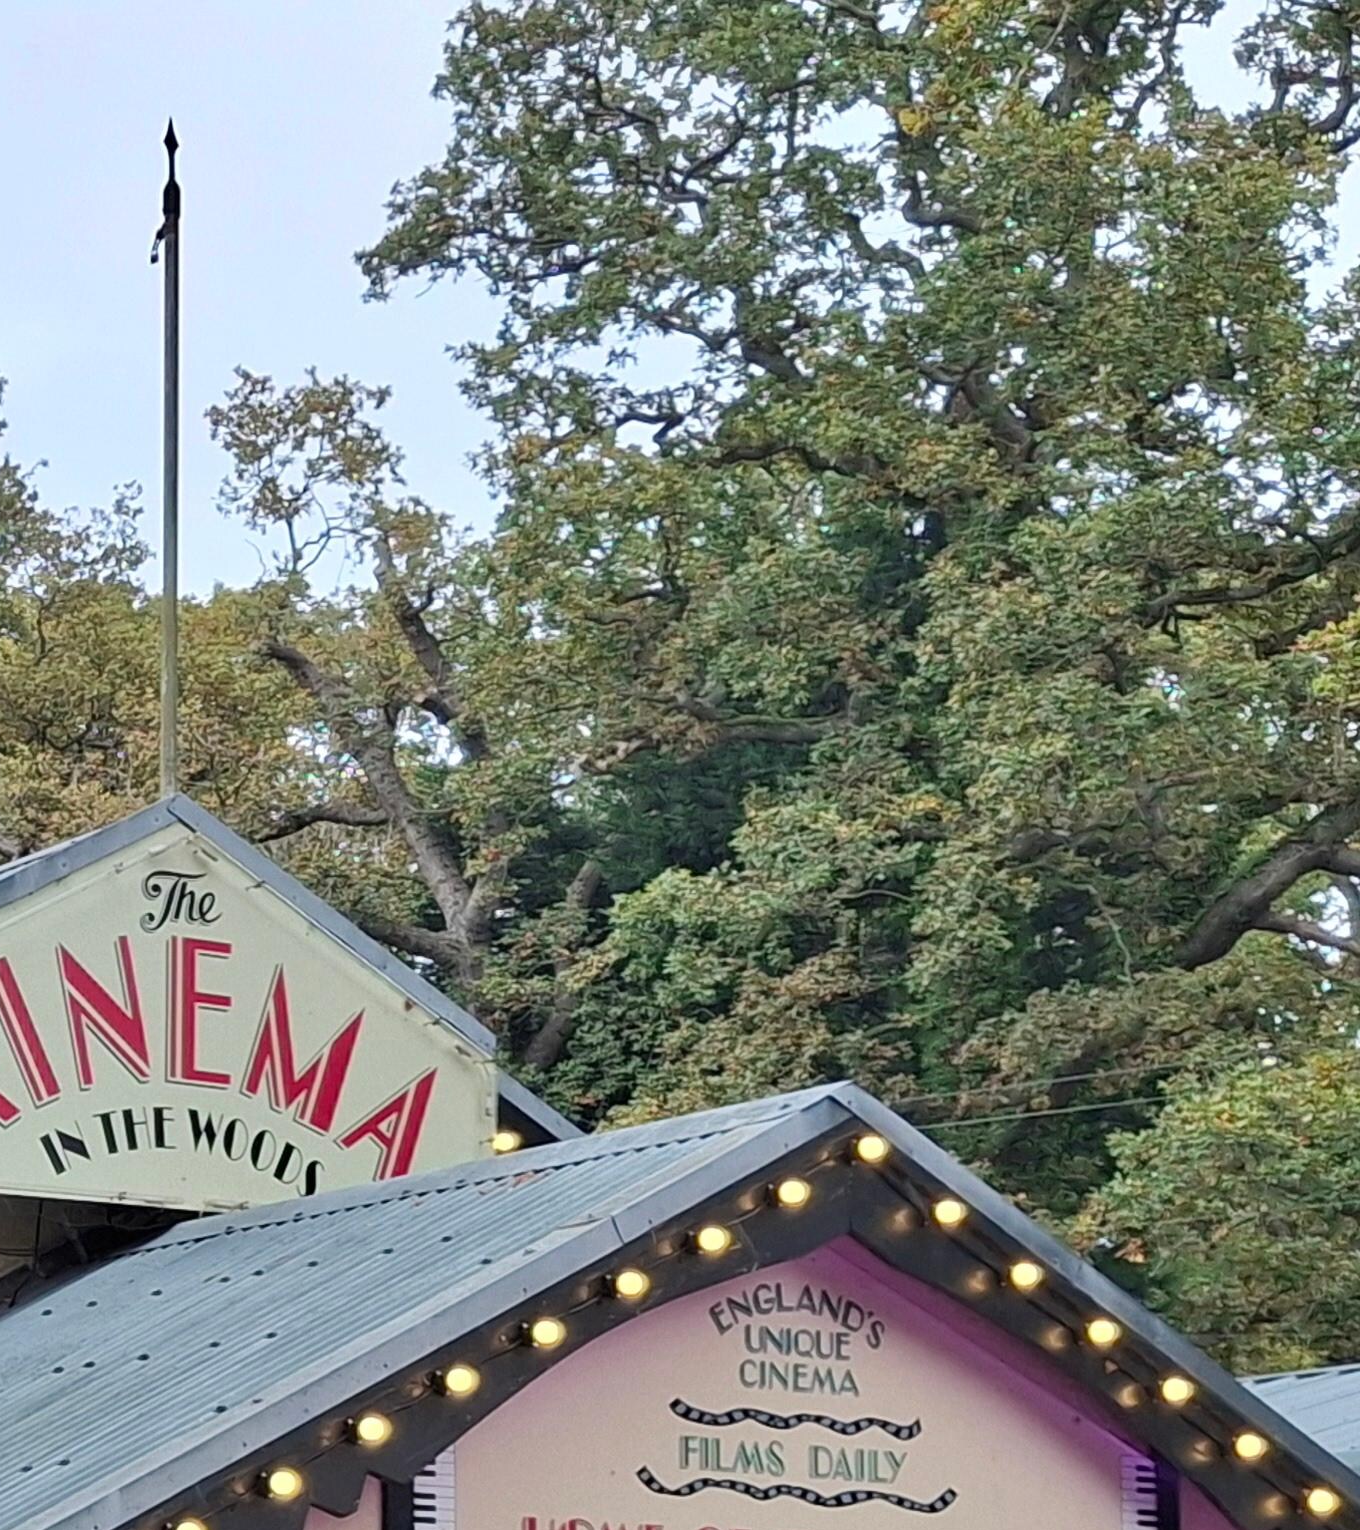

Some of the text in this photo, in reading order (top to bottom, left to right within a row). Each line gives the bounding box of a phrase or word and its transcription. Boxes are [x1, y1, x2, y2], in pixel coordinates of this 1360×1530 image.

[139, 868, 222, 932] The
[39, 1106, 325, 1197] IN THE WOODS
[708, 1280, 886, 1349] ENGLAND'S
[744, 1324, 852, 1362] UNIQUE
[739, 1360, 859, 1397] CINEMA
[679, 1434, 909, 1484] FILMS DAILY
